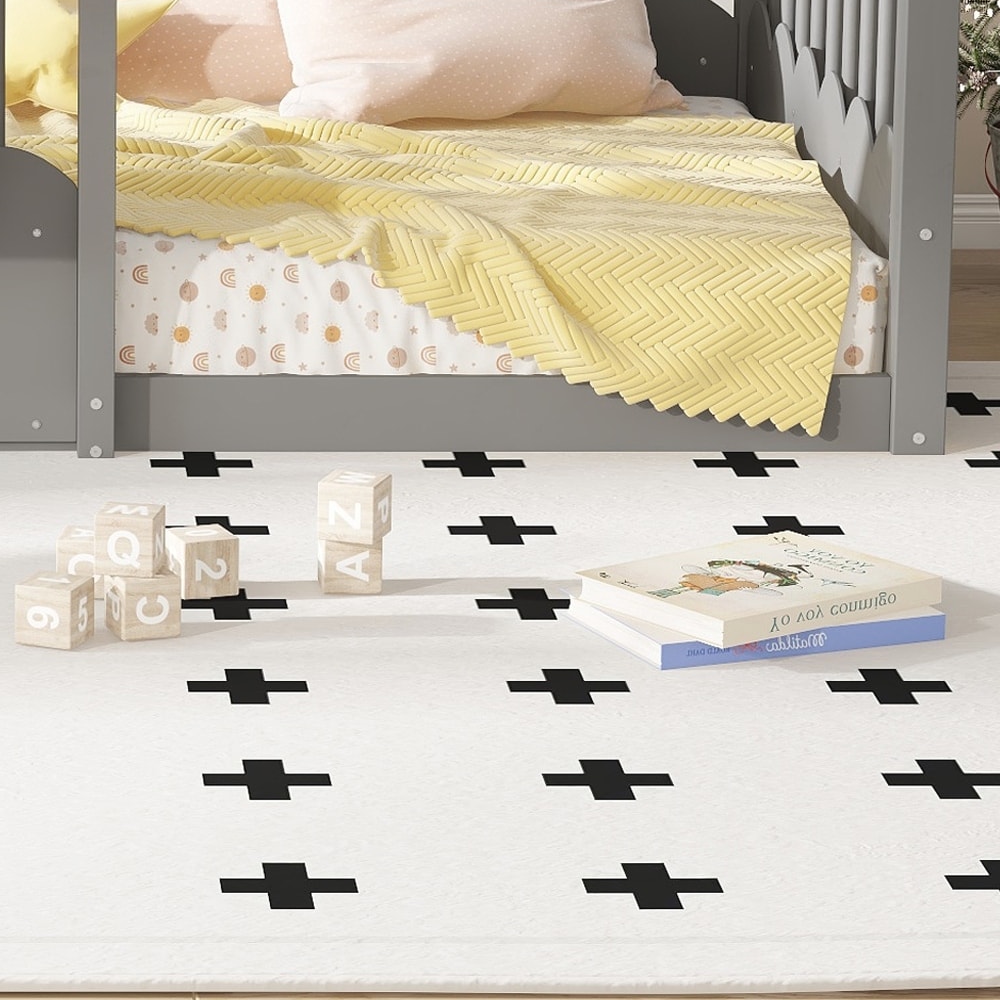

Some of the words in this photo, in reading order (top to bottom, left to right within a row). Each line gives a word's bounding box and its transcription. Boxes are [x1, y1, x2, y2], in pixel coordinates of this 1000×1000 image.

[107, 530, 141, 569] Q
[195, 558, 228, 582] 2
[336, 550, 370, 583] A
[78, 596, 88, 632] 5
[136, 595, 170, 625] C
